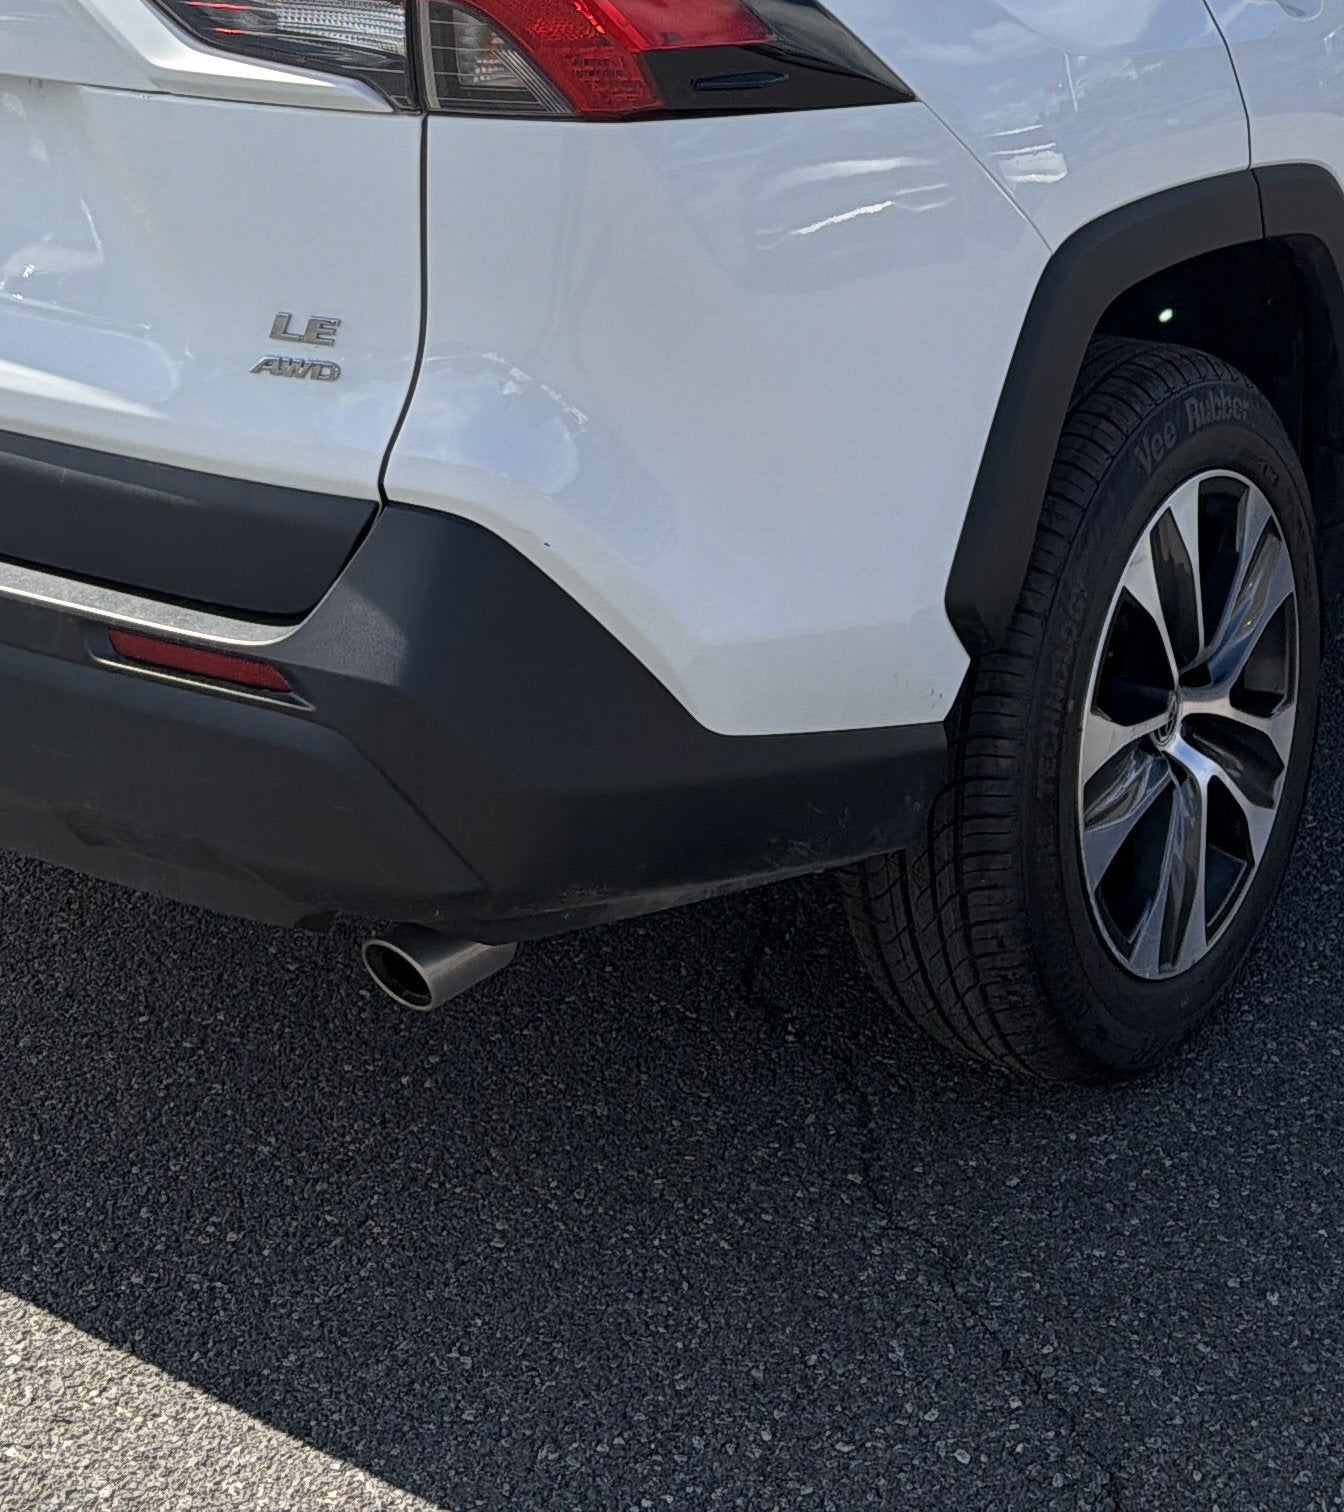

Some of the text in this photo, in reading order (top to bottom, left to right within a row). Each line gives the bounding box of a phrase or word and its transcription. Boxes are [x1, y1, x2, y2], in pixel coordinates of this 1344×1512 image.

[269, 311, 342, 347] LE
[249, 354, 342, 382] AWD
[1134, 389, 1250, 475] Vee Rubber
